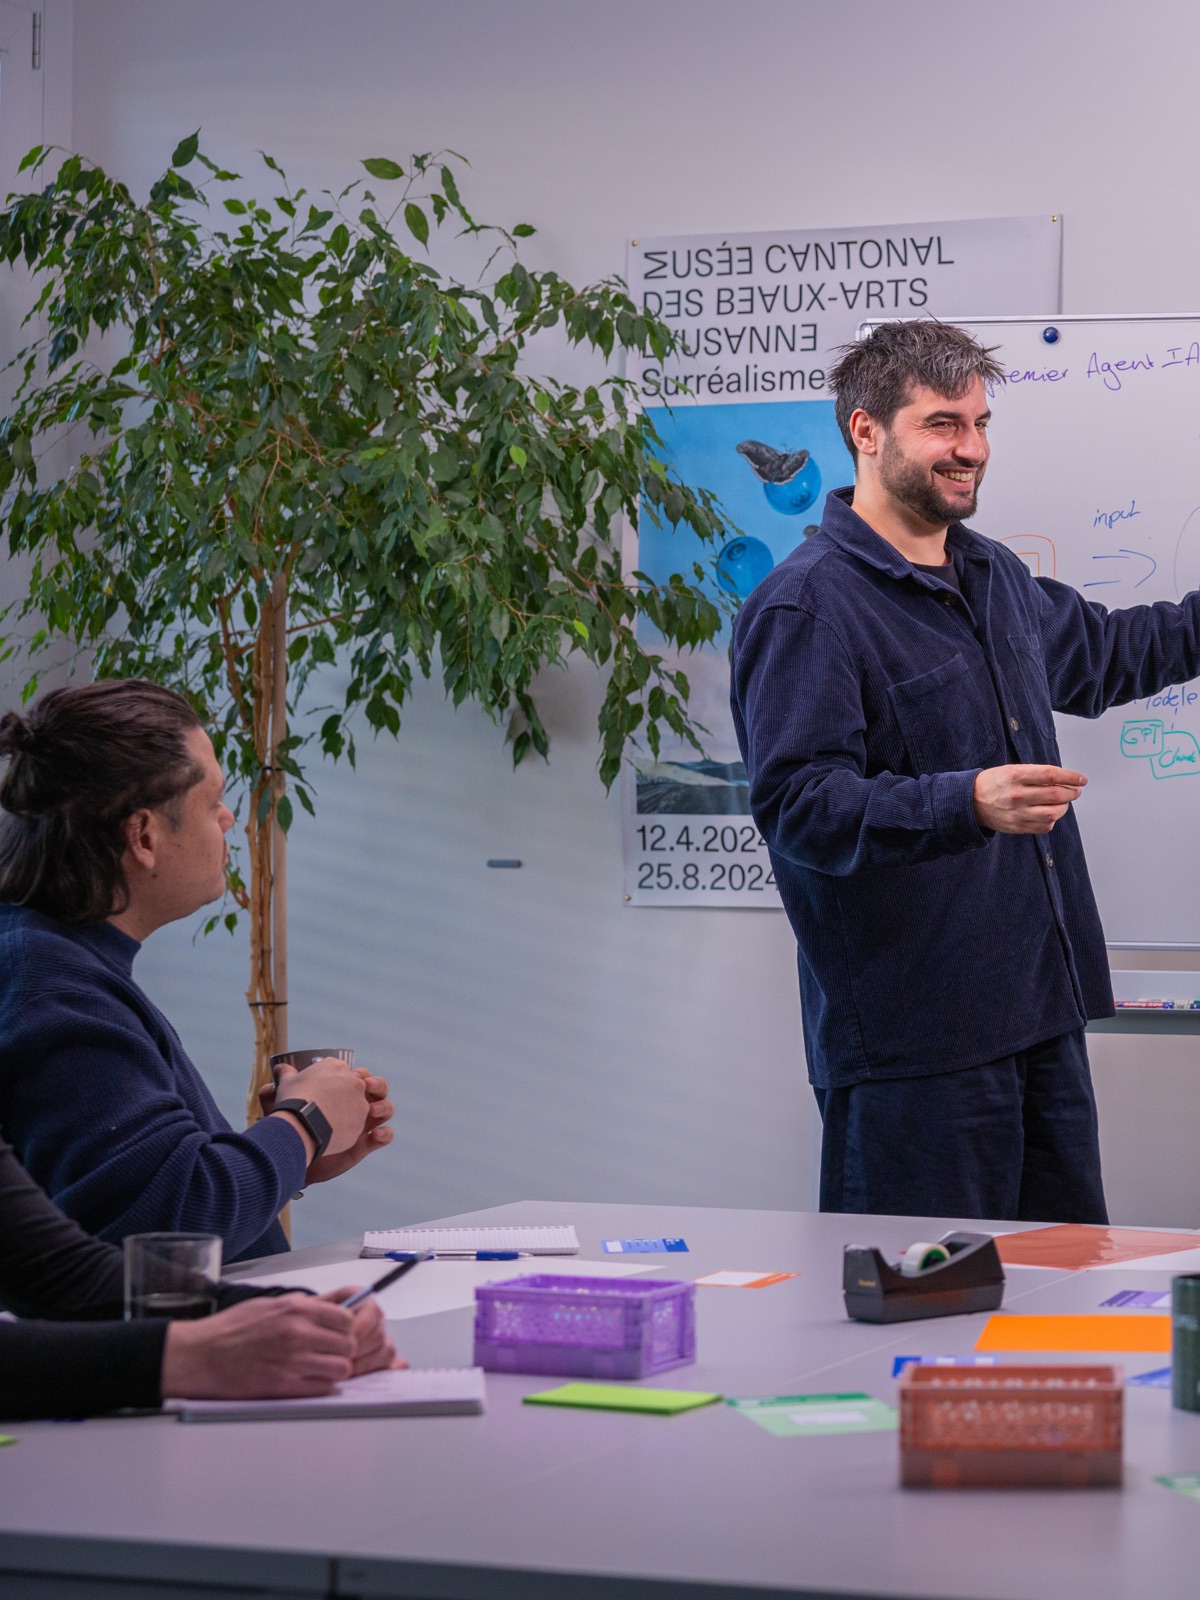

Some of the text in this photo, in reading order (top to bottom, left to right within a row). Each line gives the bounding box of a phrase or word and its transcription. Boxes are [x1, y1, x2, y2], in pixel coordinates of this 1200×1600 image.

[765, 236, 955, 274] CANTONAL
[643, 277, 929, 319] DES BEAUX-ARTS
[641, 363, 827, 398] Surréalisme
[1086, 352, 1155, 392] Agent
[1093, 499, 1142, 530] input
[1121, 723, 1162, 745] GPT
